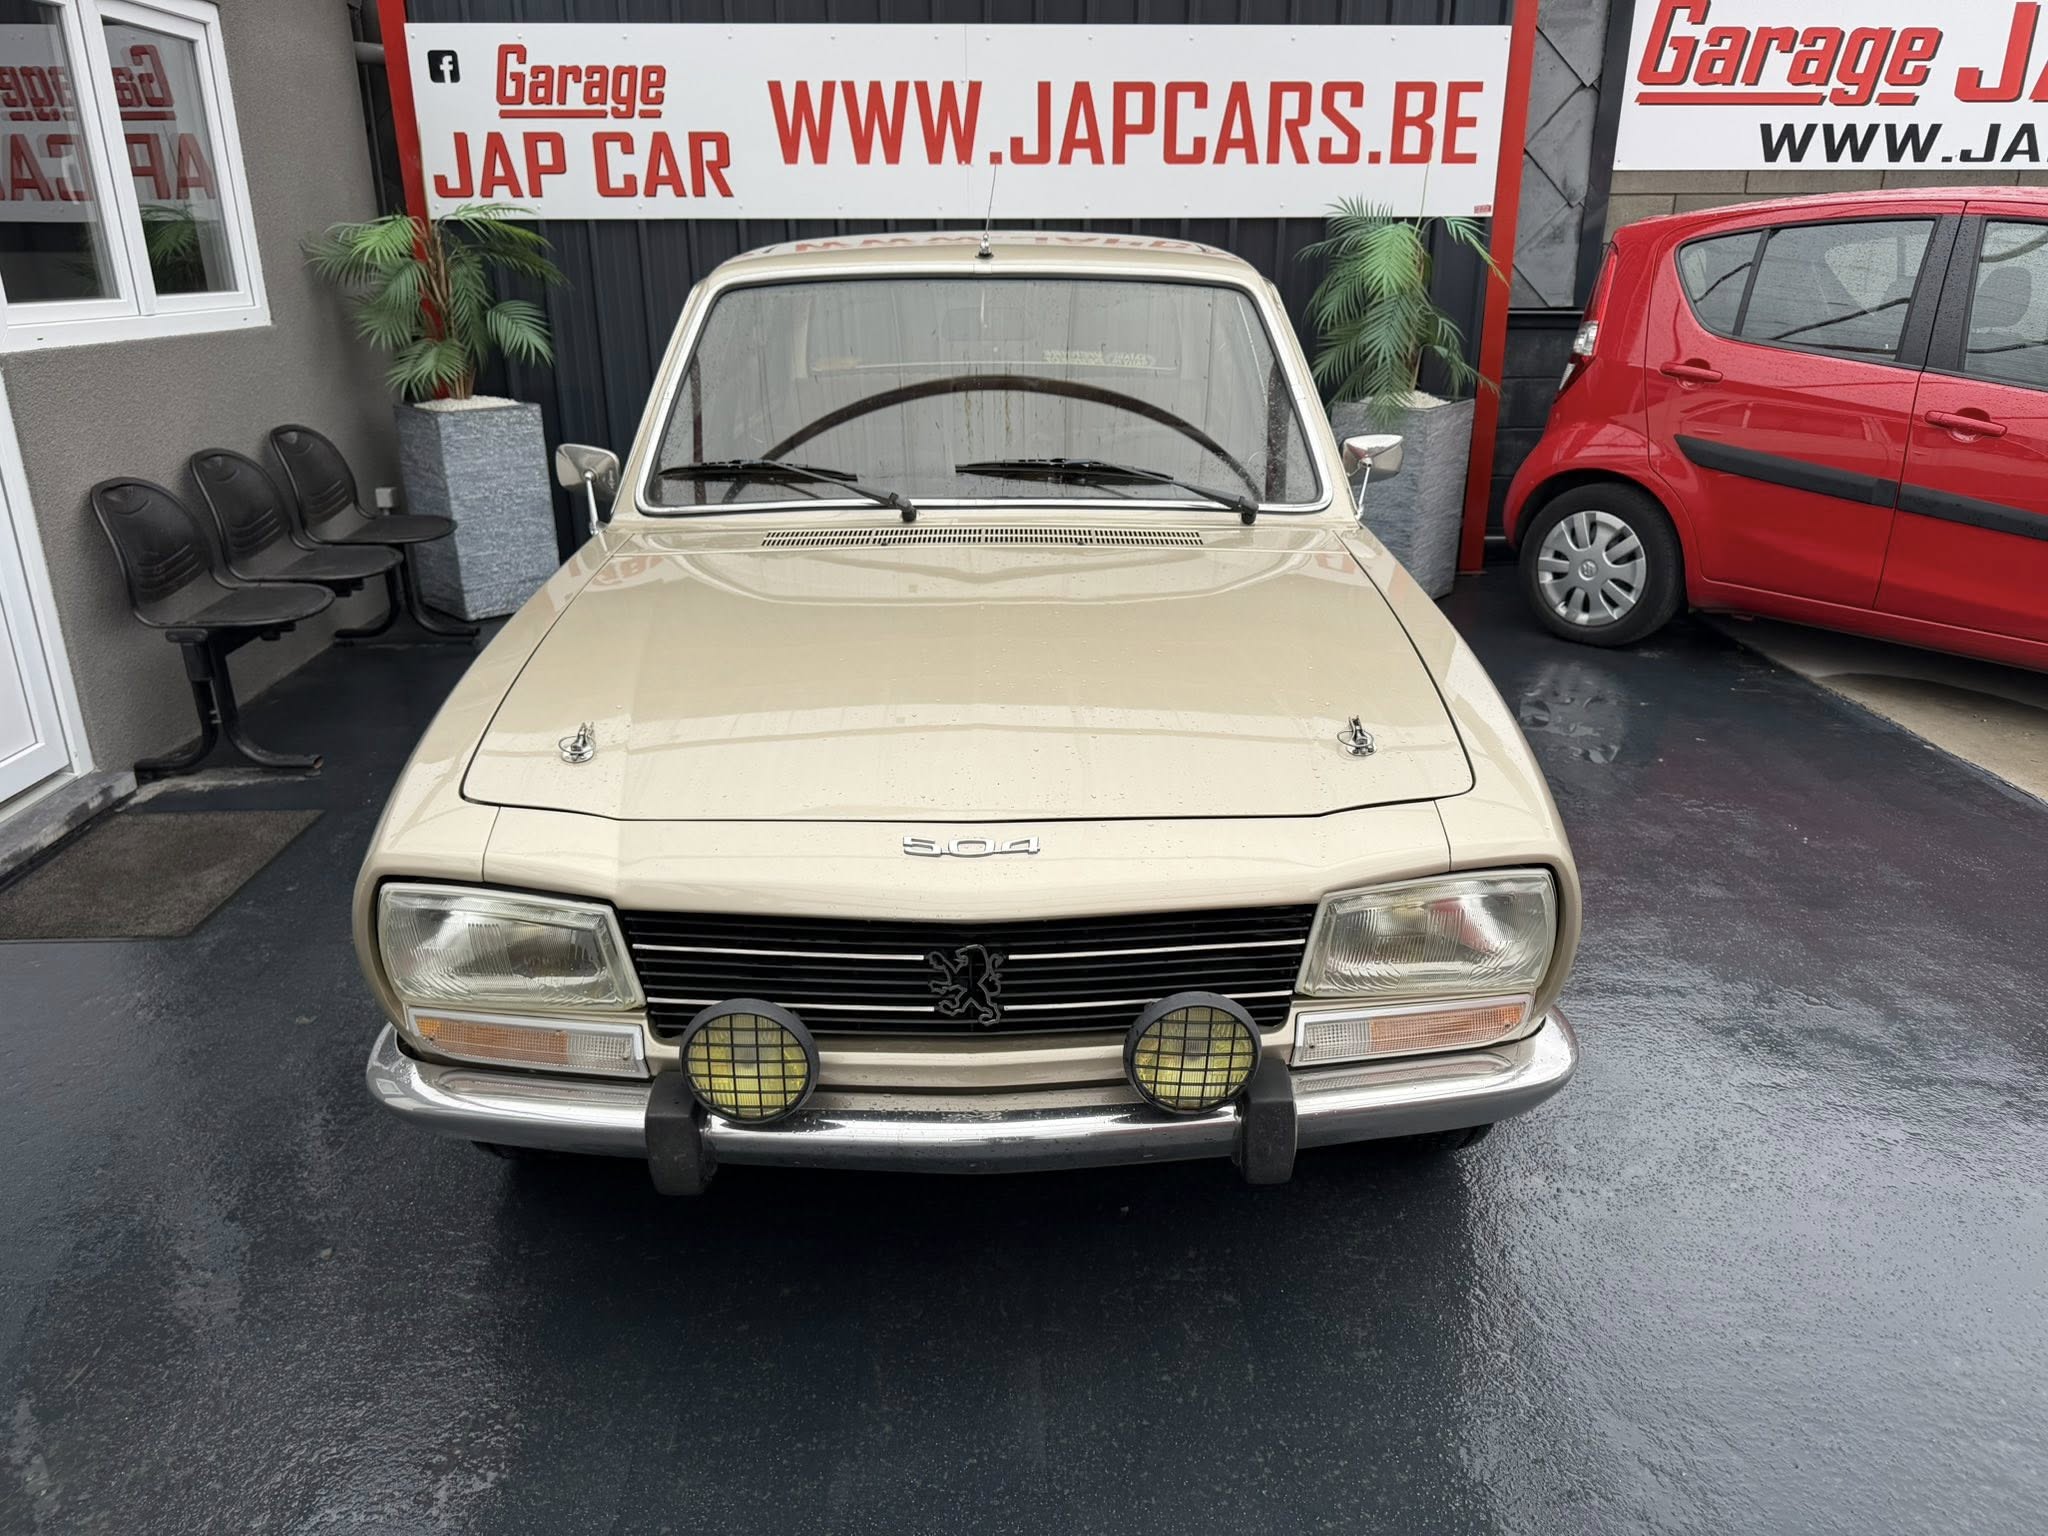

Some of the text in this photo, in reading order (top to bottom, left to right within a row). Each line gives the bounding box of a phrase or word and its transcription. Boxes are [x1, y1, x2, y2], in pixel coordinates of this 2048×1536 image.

[496, 44, 667, 119] Garage
[1636, 0, 2048, 106] Garage J
[767, 80, 1485, 165] WWW.JAPCARS.BE
[1760, 123, 2048, 163] WWW.JA
[433, 131, 734, 198] JAP CAR
[903, 837, 1040, 857] 504
